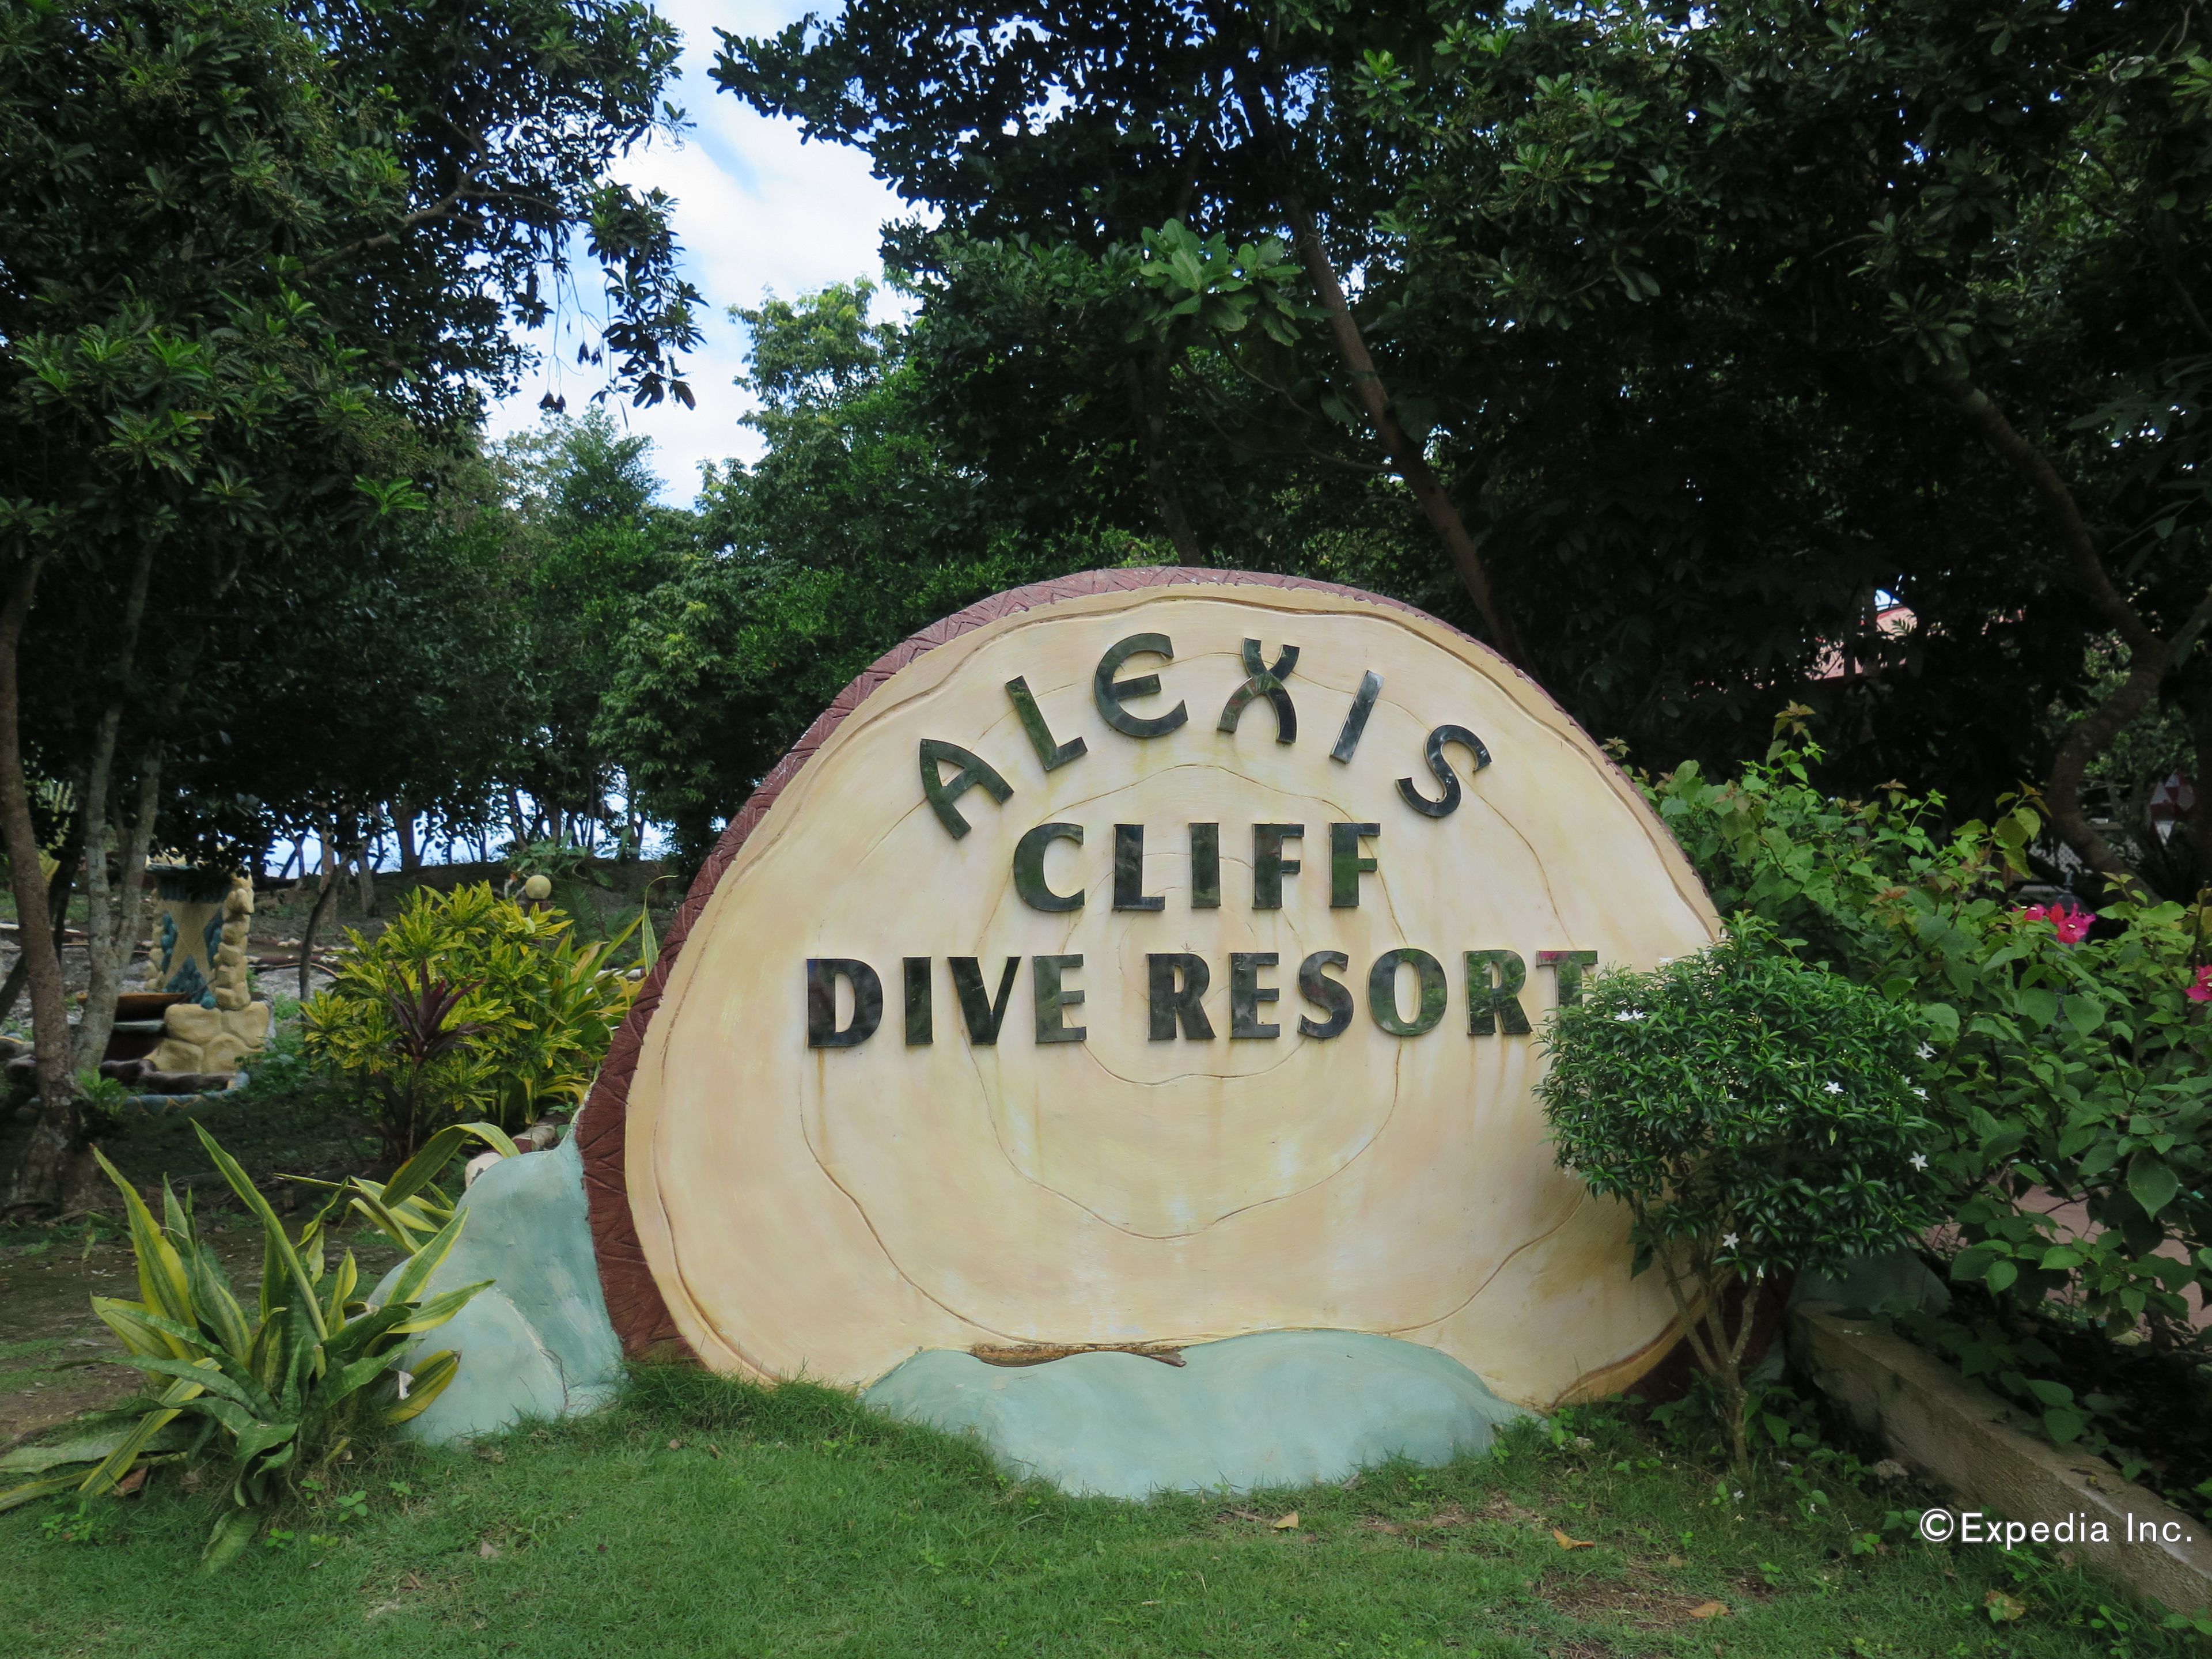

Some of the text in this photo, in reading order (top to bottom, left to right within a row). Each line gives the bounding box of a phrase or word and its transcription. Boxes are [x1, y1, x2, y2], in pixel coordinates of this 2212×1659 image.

[919, 631, 1492, 840] ALEXIS
[1013, 822, 1381, 912] CLIFF
[805, 948, 1599, 1048] DIVE RESORT
